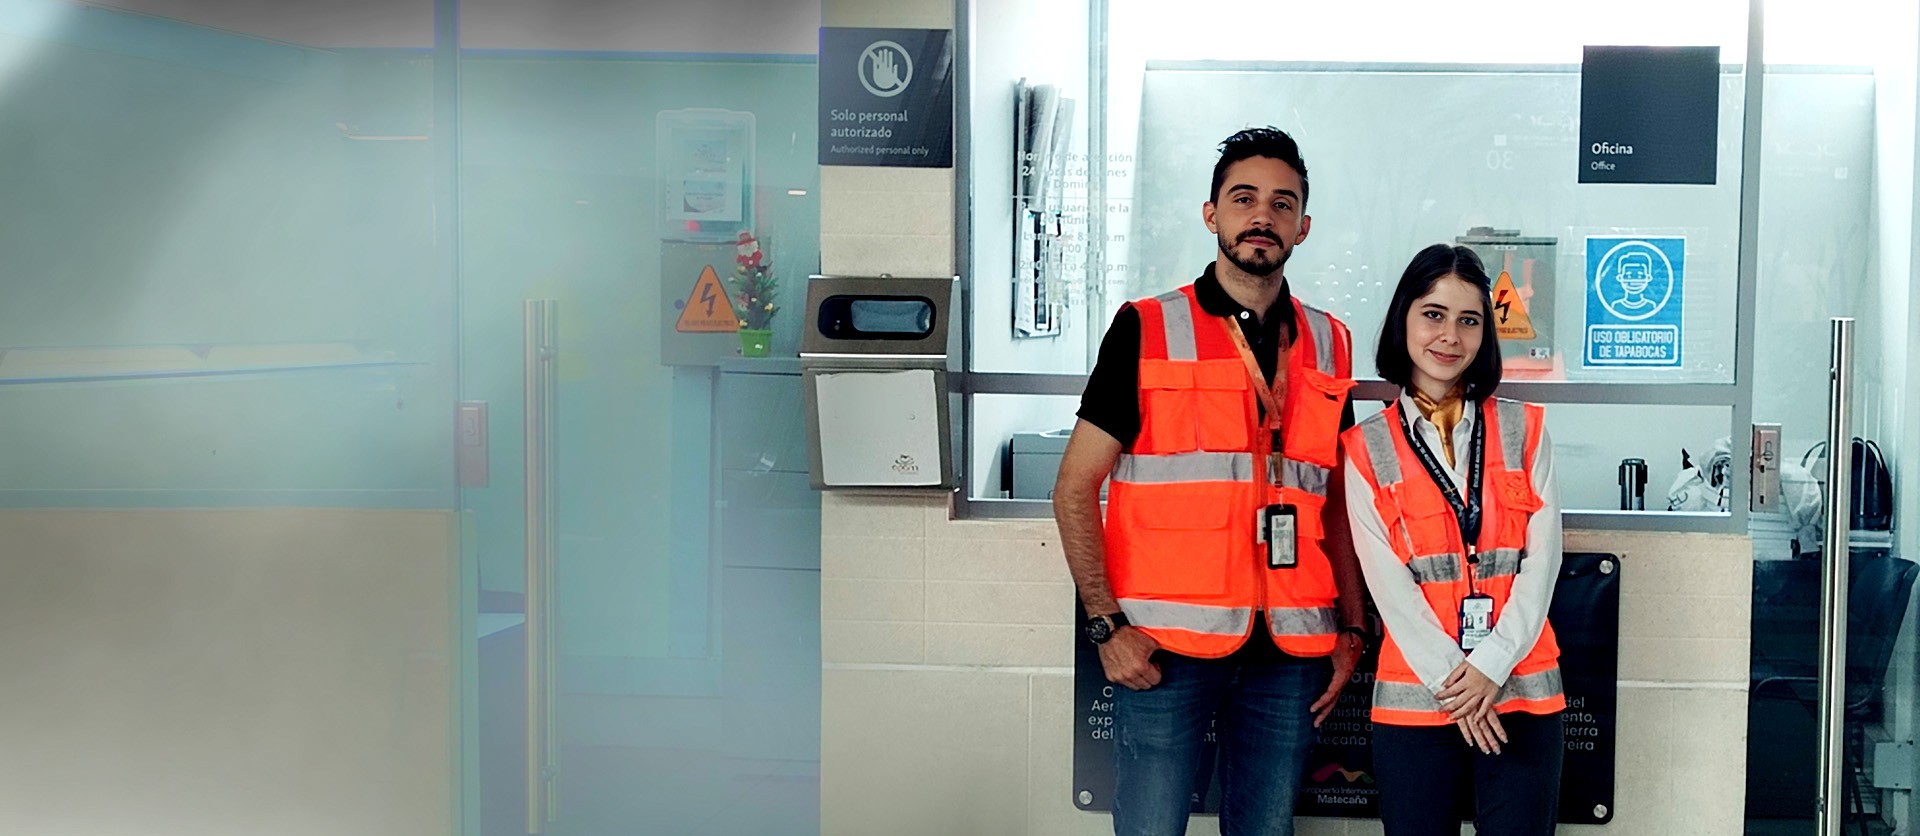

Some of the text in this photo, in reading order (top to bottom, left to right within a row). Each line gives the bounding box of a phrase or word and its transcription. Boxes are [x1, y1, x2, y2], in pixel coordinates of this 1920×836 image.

[830, 109, 909, 124] Solo personal
[830, 126, 893, 138] autorizado
[830, 145, 930, 157] Authorized personal only
[1591, 141, 1633, 154] Oficina
[1591, 160, 1616, 170] Office
[1593, 331, 1674, 344] USO OBLIGATORIO
[1599, 345, 1667, 358] DE TAPABOCAS
[1092, 699, 1114, 711] Aer
[1561, 712, 1596, 724] ento,
[1088, 715, 1113, 728] exp
[1565, 724, 1598, 737] ierra
[1092, 727, 1114, 740] del
[1317, 793, 1368, 805] Matecaña
